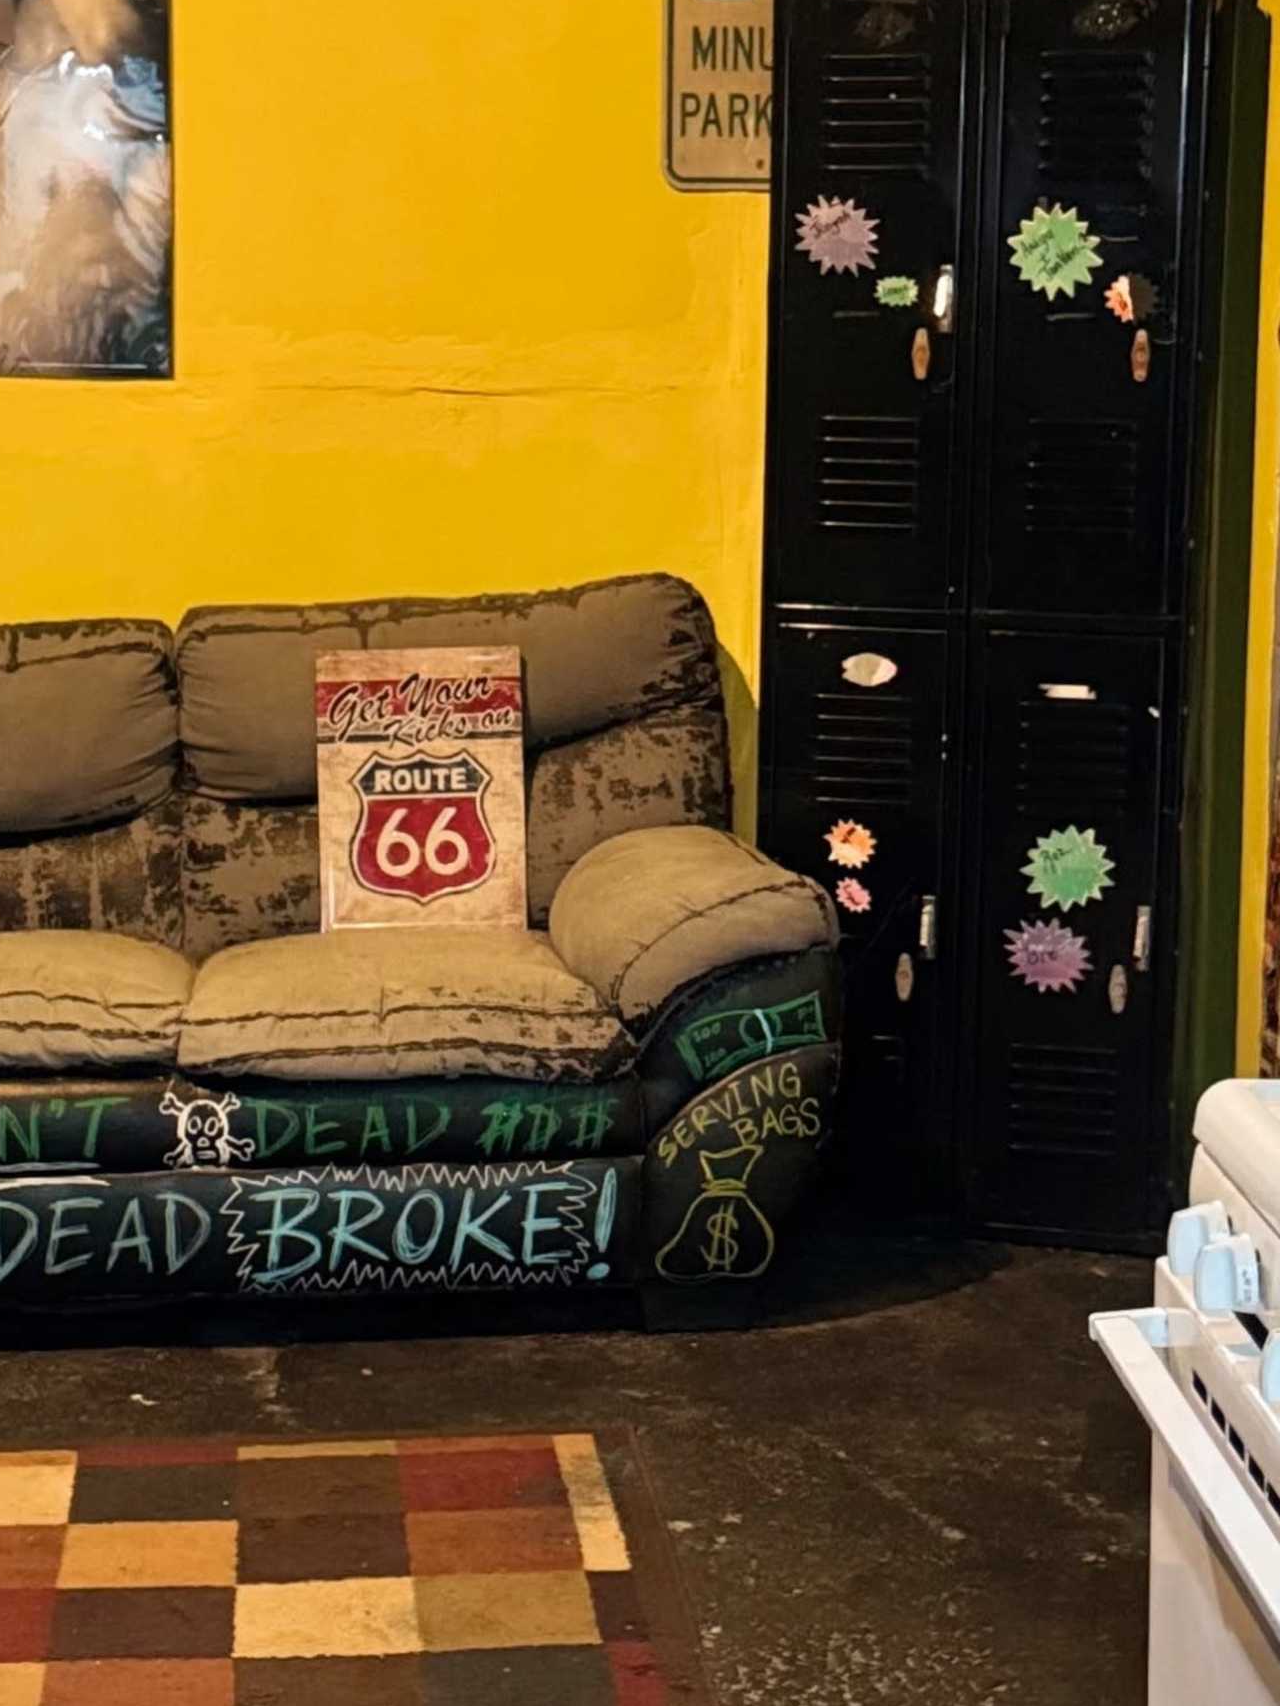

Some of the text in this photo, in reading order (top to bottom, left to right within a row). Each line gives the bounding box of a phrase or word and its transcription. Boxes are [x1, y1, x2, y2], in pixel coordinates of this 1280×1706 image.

[328, 672, 493, 743] Get Your
[383, 706, 513, 749] Kicks on
[372, 767, 469, 793] ROUTE
[375, 806, 470, 878] 66
[241, 1095, 452, 1159] DEAD
[655, 1061, 802, 1169] SERVING
[729, 1095, 822, 1147] BAGS
[247, 1165, 618, 1284] BROKE!
